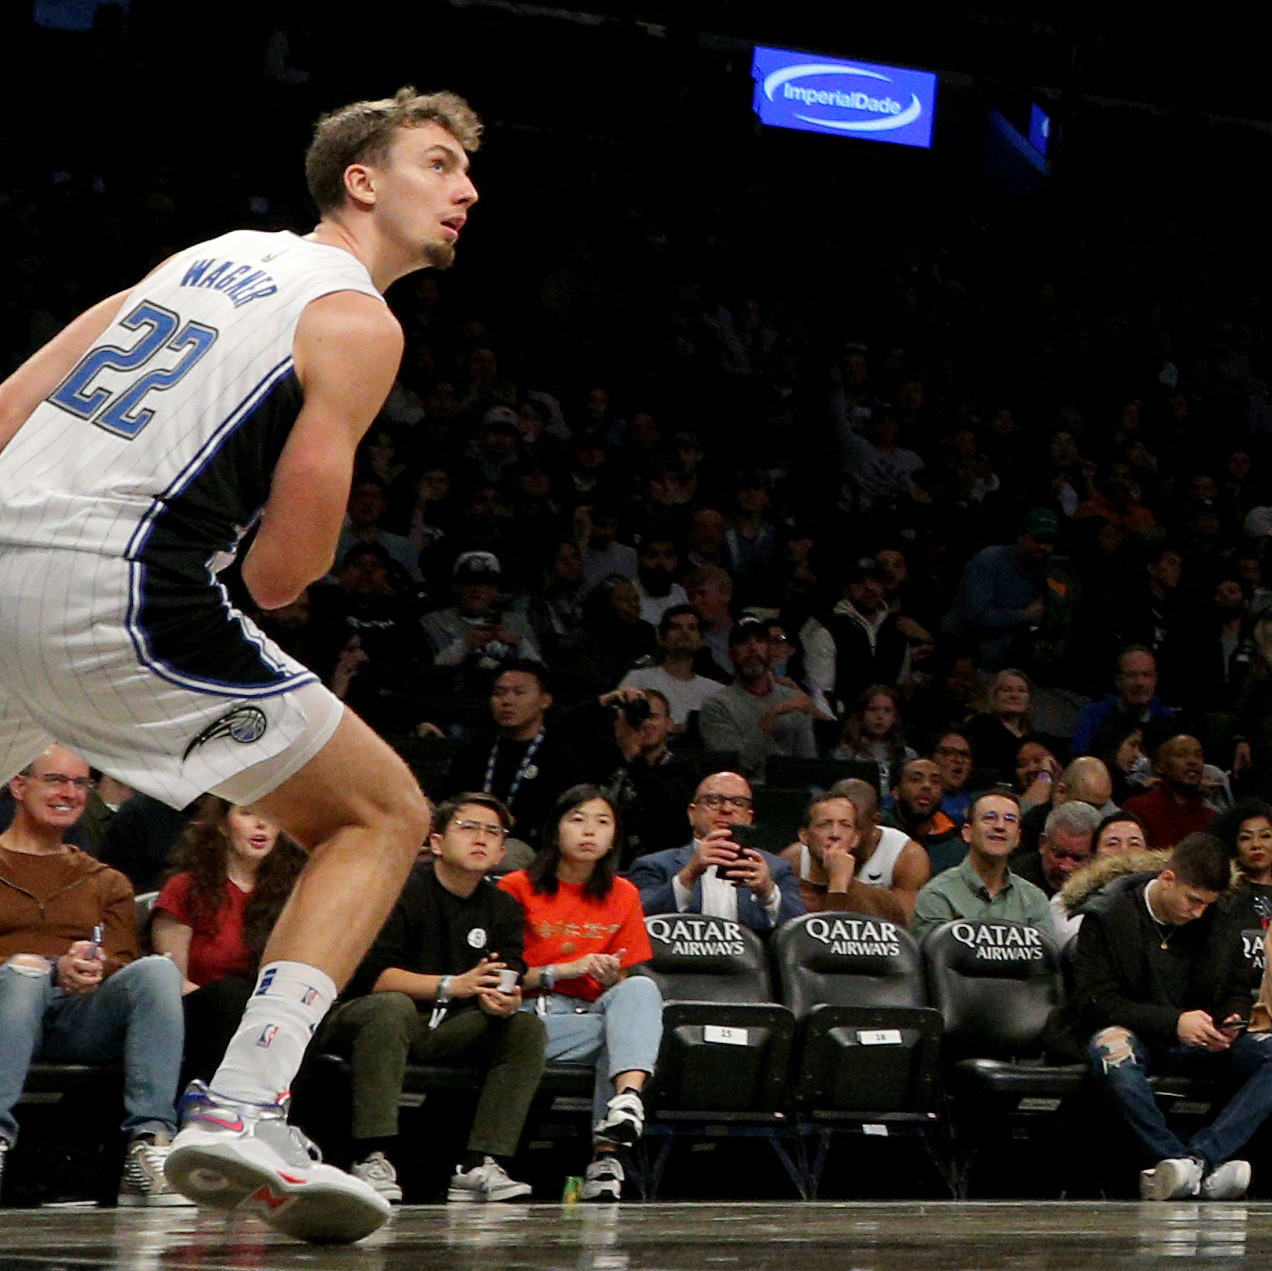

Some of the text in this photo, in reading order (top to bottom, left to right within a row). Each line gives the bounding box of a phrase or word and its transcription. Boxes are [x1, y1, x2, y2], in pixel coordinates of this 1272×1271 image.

[783, 82, 903, 115] ImperialDade
[179, 258, 278, 309] WAGNER
[47, 299, 219, 441] 22
[645, 918, 744, 944] QATAR
[804, 917, 899, 944] QATAR
[951, 922, 1042, 948] QATAR
[671, 939, 746, 957] AIRWAYS
[830, 939, 901, 958] AIRWAYS
[975, 944, 1044, 962] AIRWAYS
